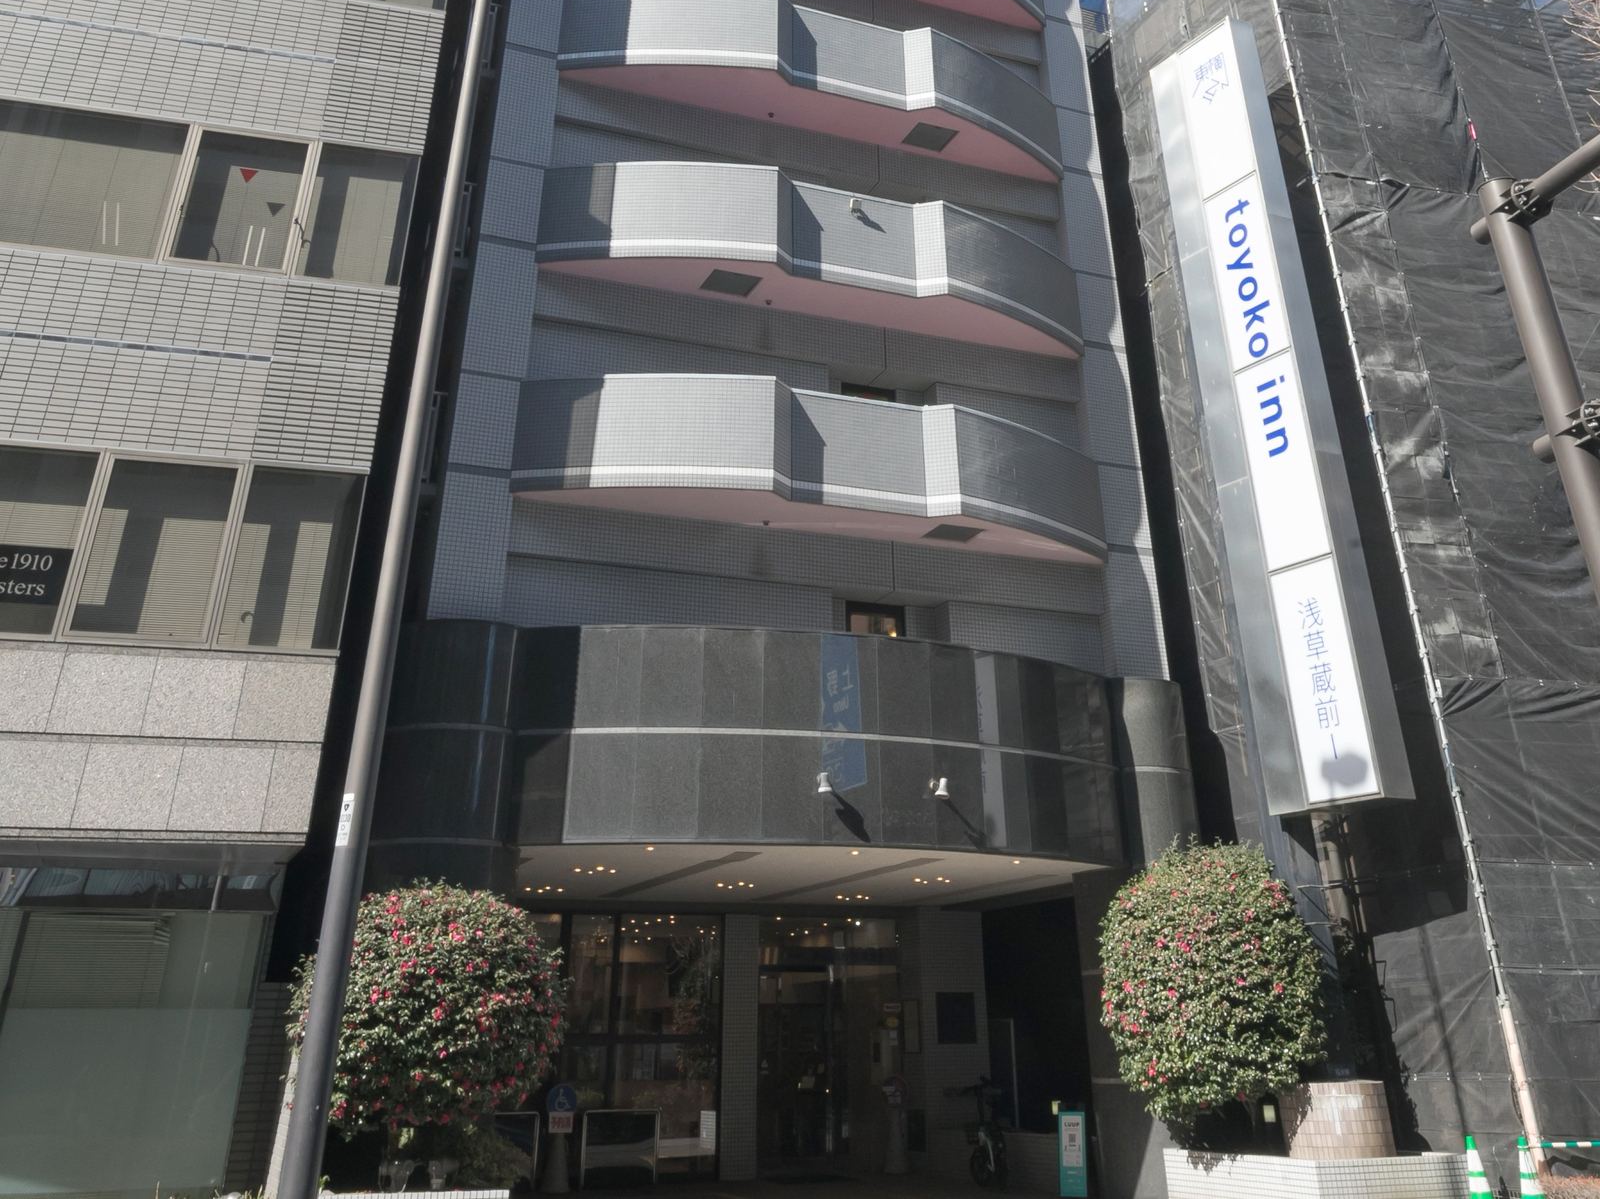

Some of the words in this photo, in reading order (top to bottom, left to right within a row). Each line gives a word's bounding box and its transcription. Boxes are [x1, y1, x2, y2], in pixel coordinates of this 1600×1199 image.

[1225, 198, 1271, 358] toyoko
[1256, 375, 1289, 458] inn
[11, 553, 53, 571] 1910
